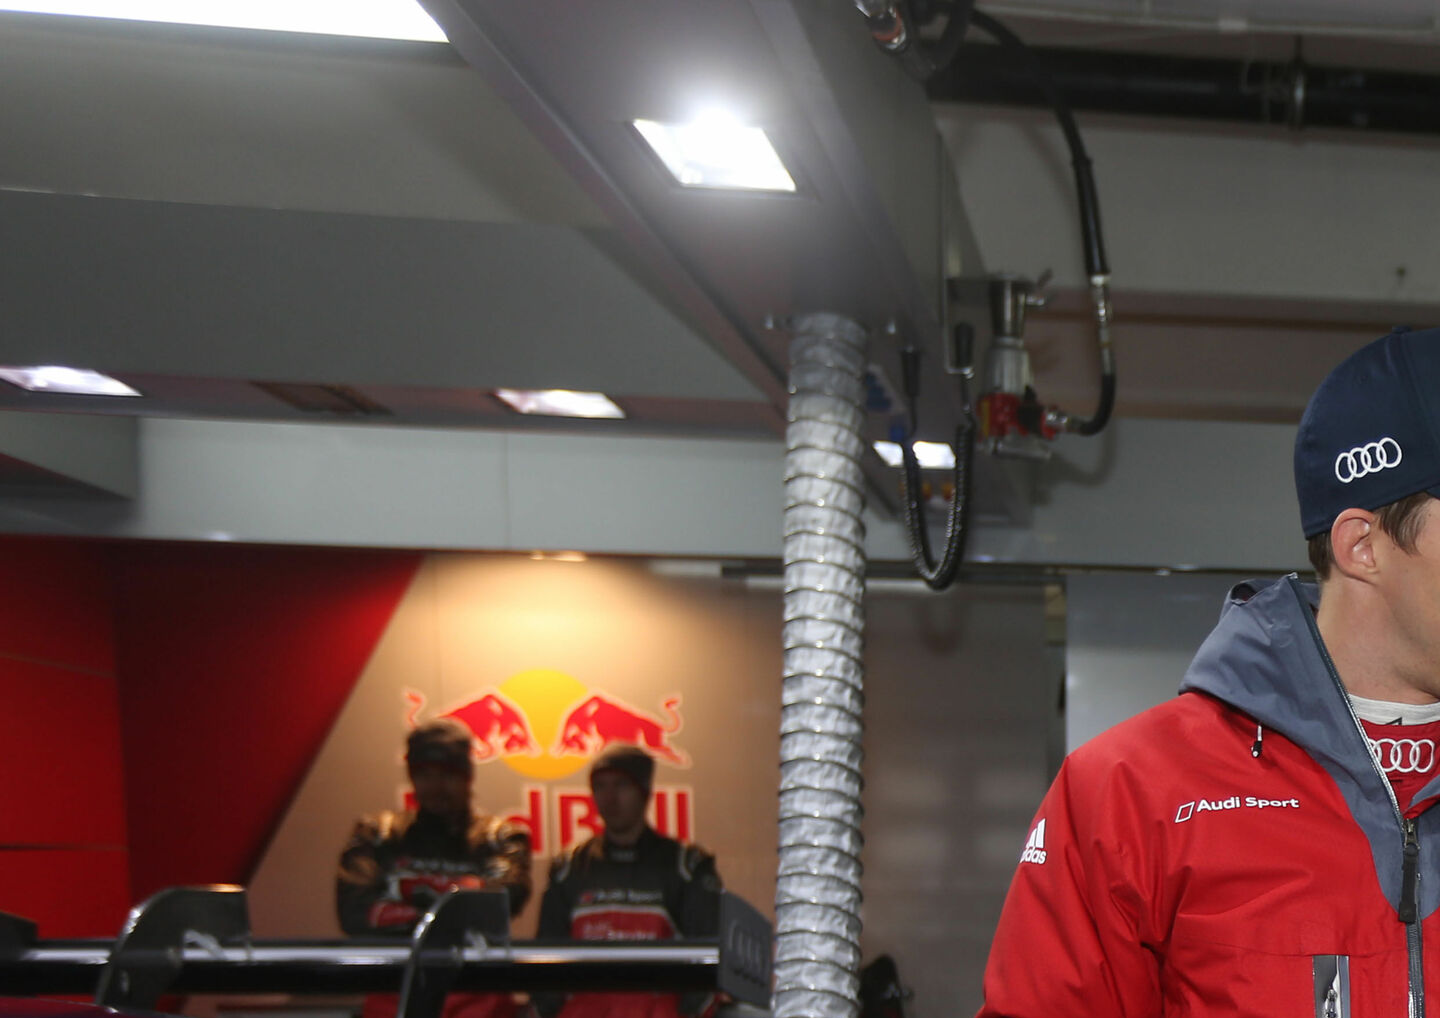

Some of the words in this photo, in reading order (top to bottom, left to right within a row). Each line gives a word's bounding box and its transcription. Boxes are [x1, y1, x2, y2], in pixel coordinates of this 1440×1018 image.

[559, 791, 688, 846] Bll
[1197, 797, 1241, 812] Audi
[1245, 797, 1299, 808] Sport
